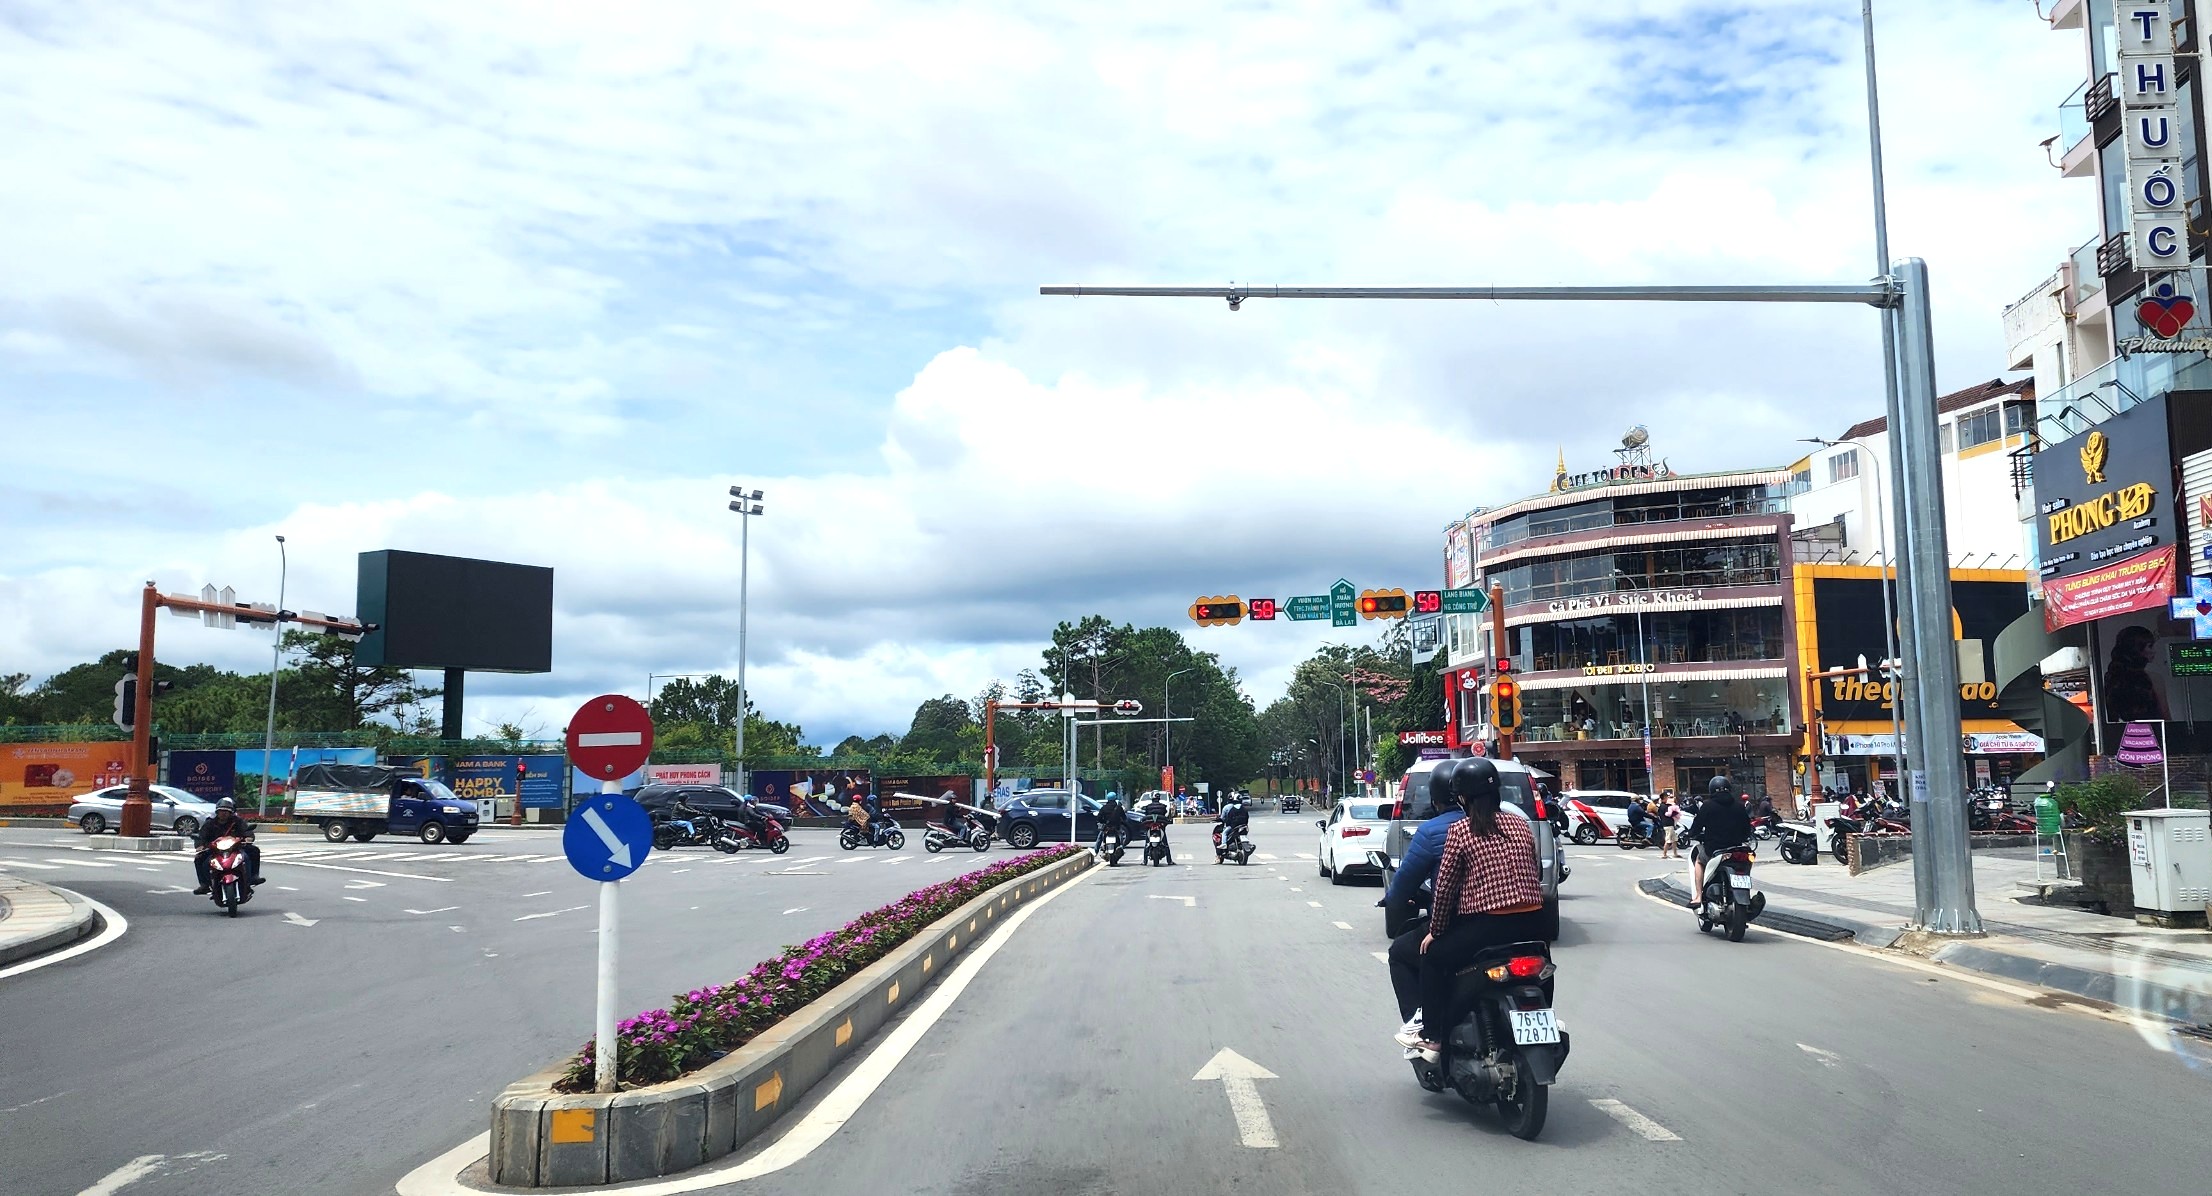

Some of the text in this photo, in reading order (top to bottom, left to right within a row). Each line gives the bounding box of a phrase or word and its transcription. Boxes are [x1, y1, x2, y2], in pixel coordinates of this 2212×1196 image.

[2049, 494, 2114, 545] PHONG
[2100, 572, 2116, 582] KHAI
[1444, 590, 1457, 598] LANG
[1417, 593, 1438, 612] 58
[1549, 600, 1565, 612] Cà
[1568, 598, 1591, 610] Phê
[1252, 600, 1274, 619] 58
[1402, 732, 1444, 744] Jollibee
[455, 777, 503, 788] HAPPY
[452, 787, 505, 798] COMBO
[1516, 1027, 1556, 1042] 728.71
